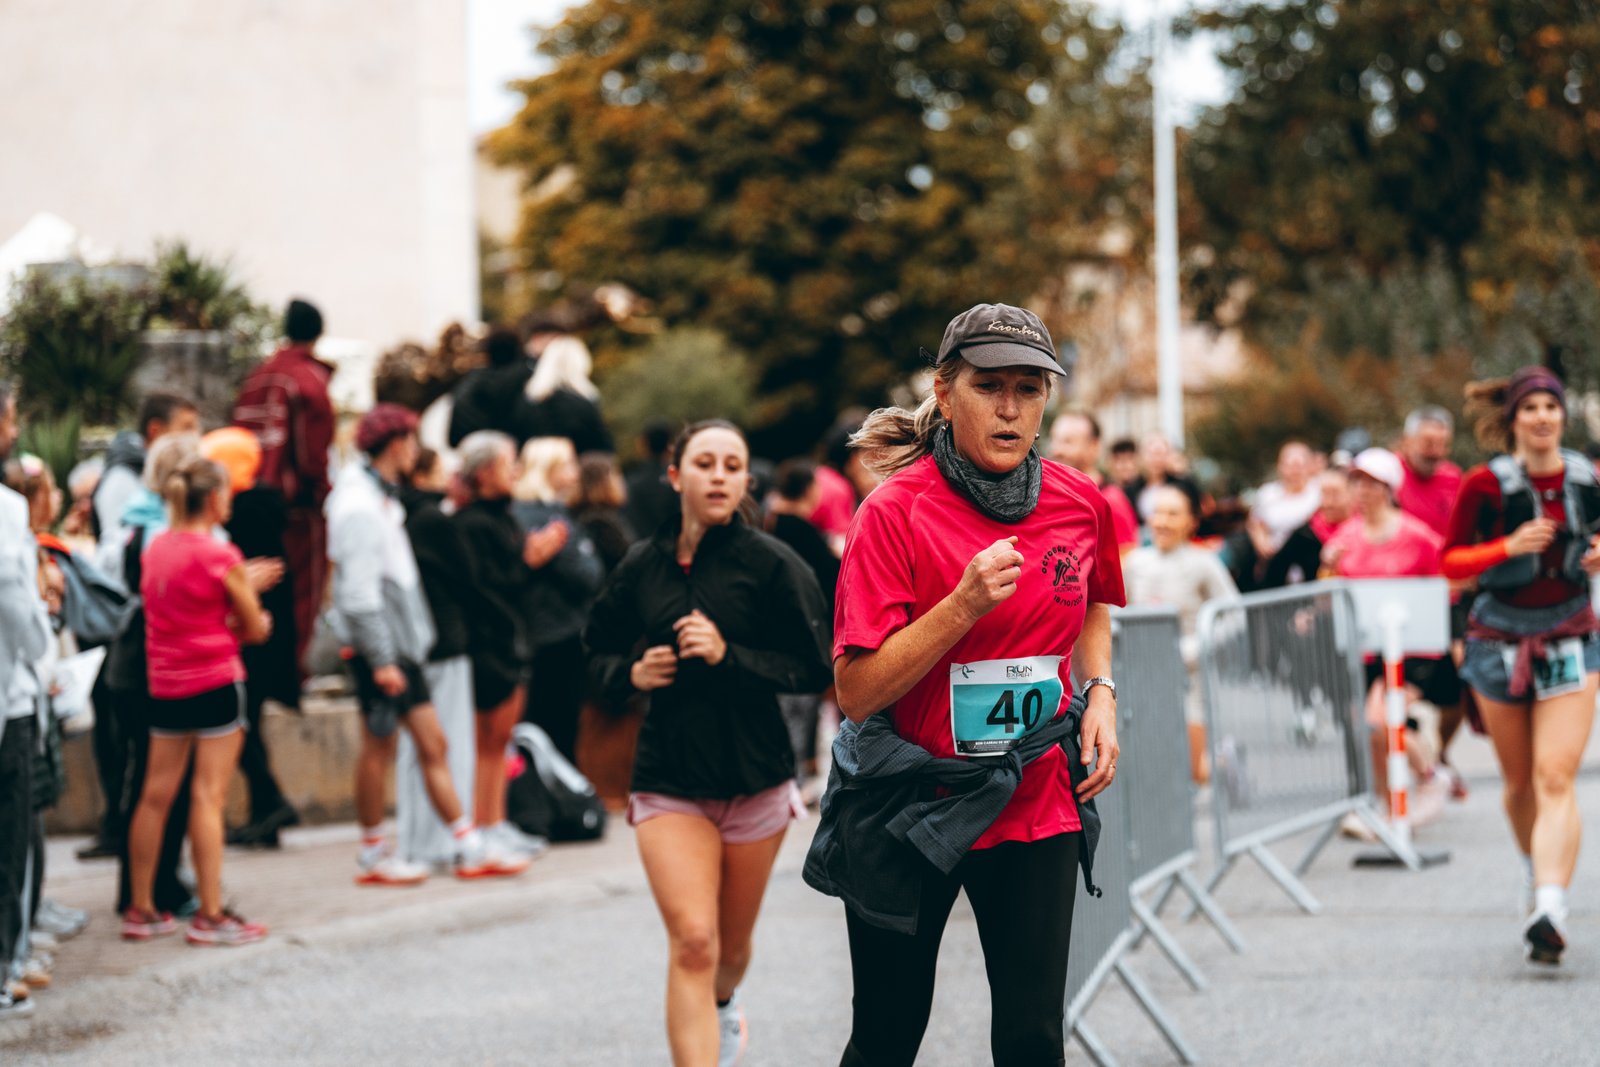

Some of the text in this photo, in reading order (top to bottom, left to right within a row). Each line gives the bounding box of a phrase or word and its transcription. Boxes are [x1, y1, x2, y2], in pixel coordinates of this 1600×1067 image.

[1042, 546, 1066, 574] OCTOBRE
[1006, 664, 1032, 674] RUN
[986, 688, 1043, 734] 40
